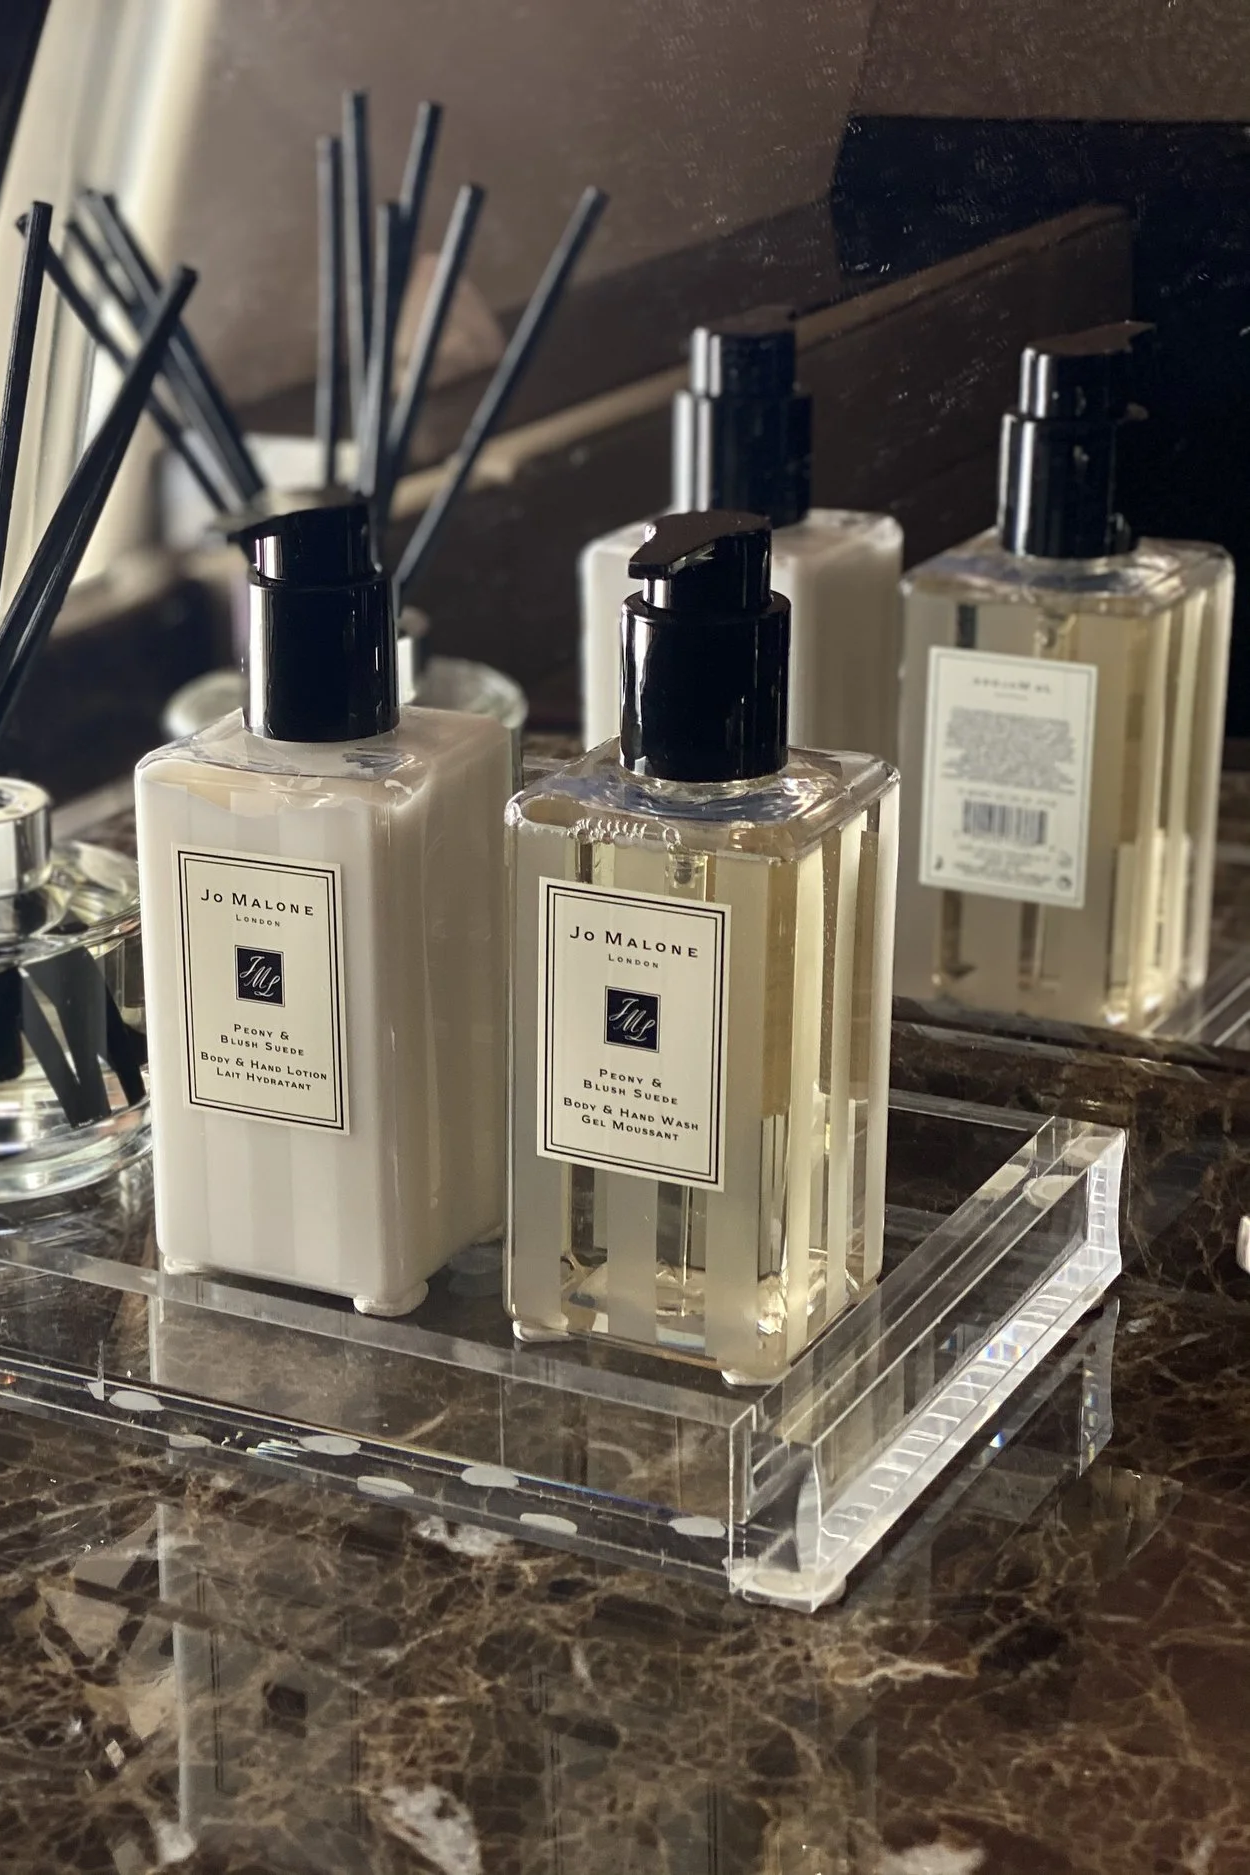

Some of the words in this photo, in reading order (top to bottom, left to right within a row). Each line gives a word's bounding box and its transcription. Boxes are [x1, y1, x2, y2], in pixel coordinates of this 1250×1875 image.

[201, 889, 223, 903] JO
[232, 892, 314, 916] MALONE
[236, 914, 281, 927] LONDON
[569, 926, 595, 942] JO
[605, 931, 698, 958] MALONE
[608, 953, 660, 968] LONDON
[233, 1023, 273, 1039] PEONY
[280, 1031, 290, 1041] &
[220, 1034, 258, 1049] BLUSH
[265, 1041, 305, 1056] SUEDE
[200, 1051, 230, 1065] BODY
[235, 1057, 245, 1067] &
[250, 1059, 282, 1073] HAND
[287, 1065, 328, 1081] LOTION
[599, 1068, 644, 1085] PEONY
[651, 1077, 662, 1088] &
[216, 1067, 241, 1080] LAIT
[246, 1072, 312, 1091] HYDRATANT
[583, 1079, 626, 1096] BLUSH
[633, 1088, 678, 1105] SUEDE
[563, 1097, 597, 1112] BODY
[602, 1104, 613, 1115] &
[620, 1107, 655, 1123] HAND
[661, 1115, 699, 1131] WASH
[581, 1114, 606, 1128] GEL
[612, 1121, 679, 1141] MOUSSANT
